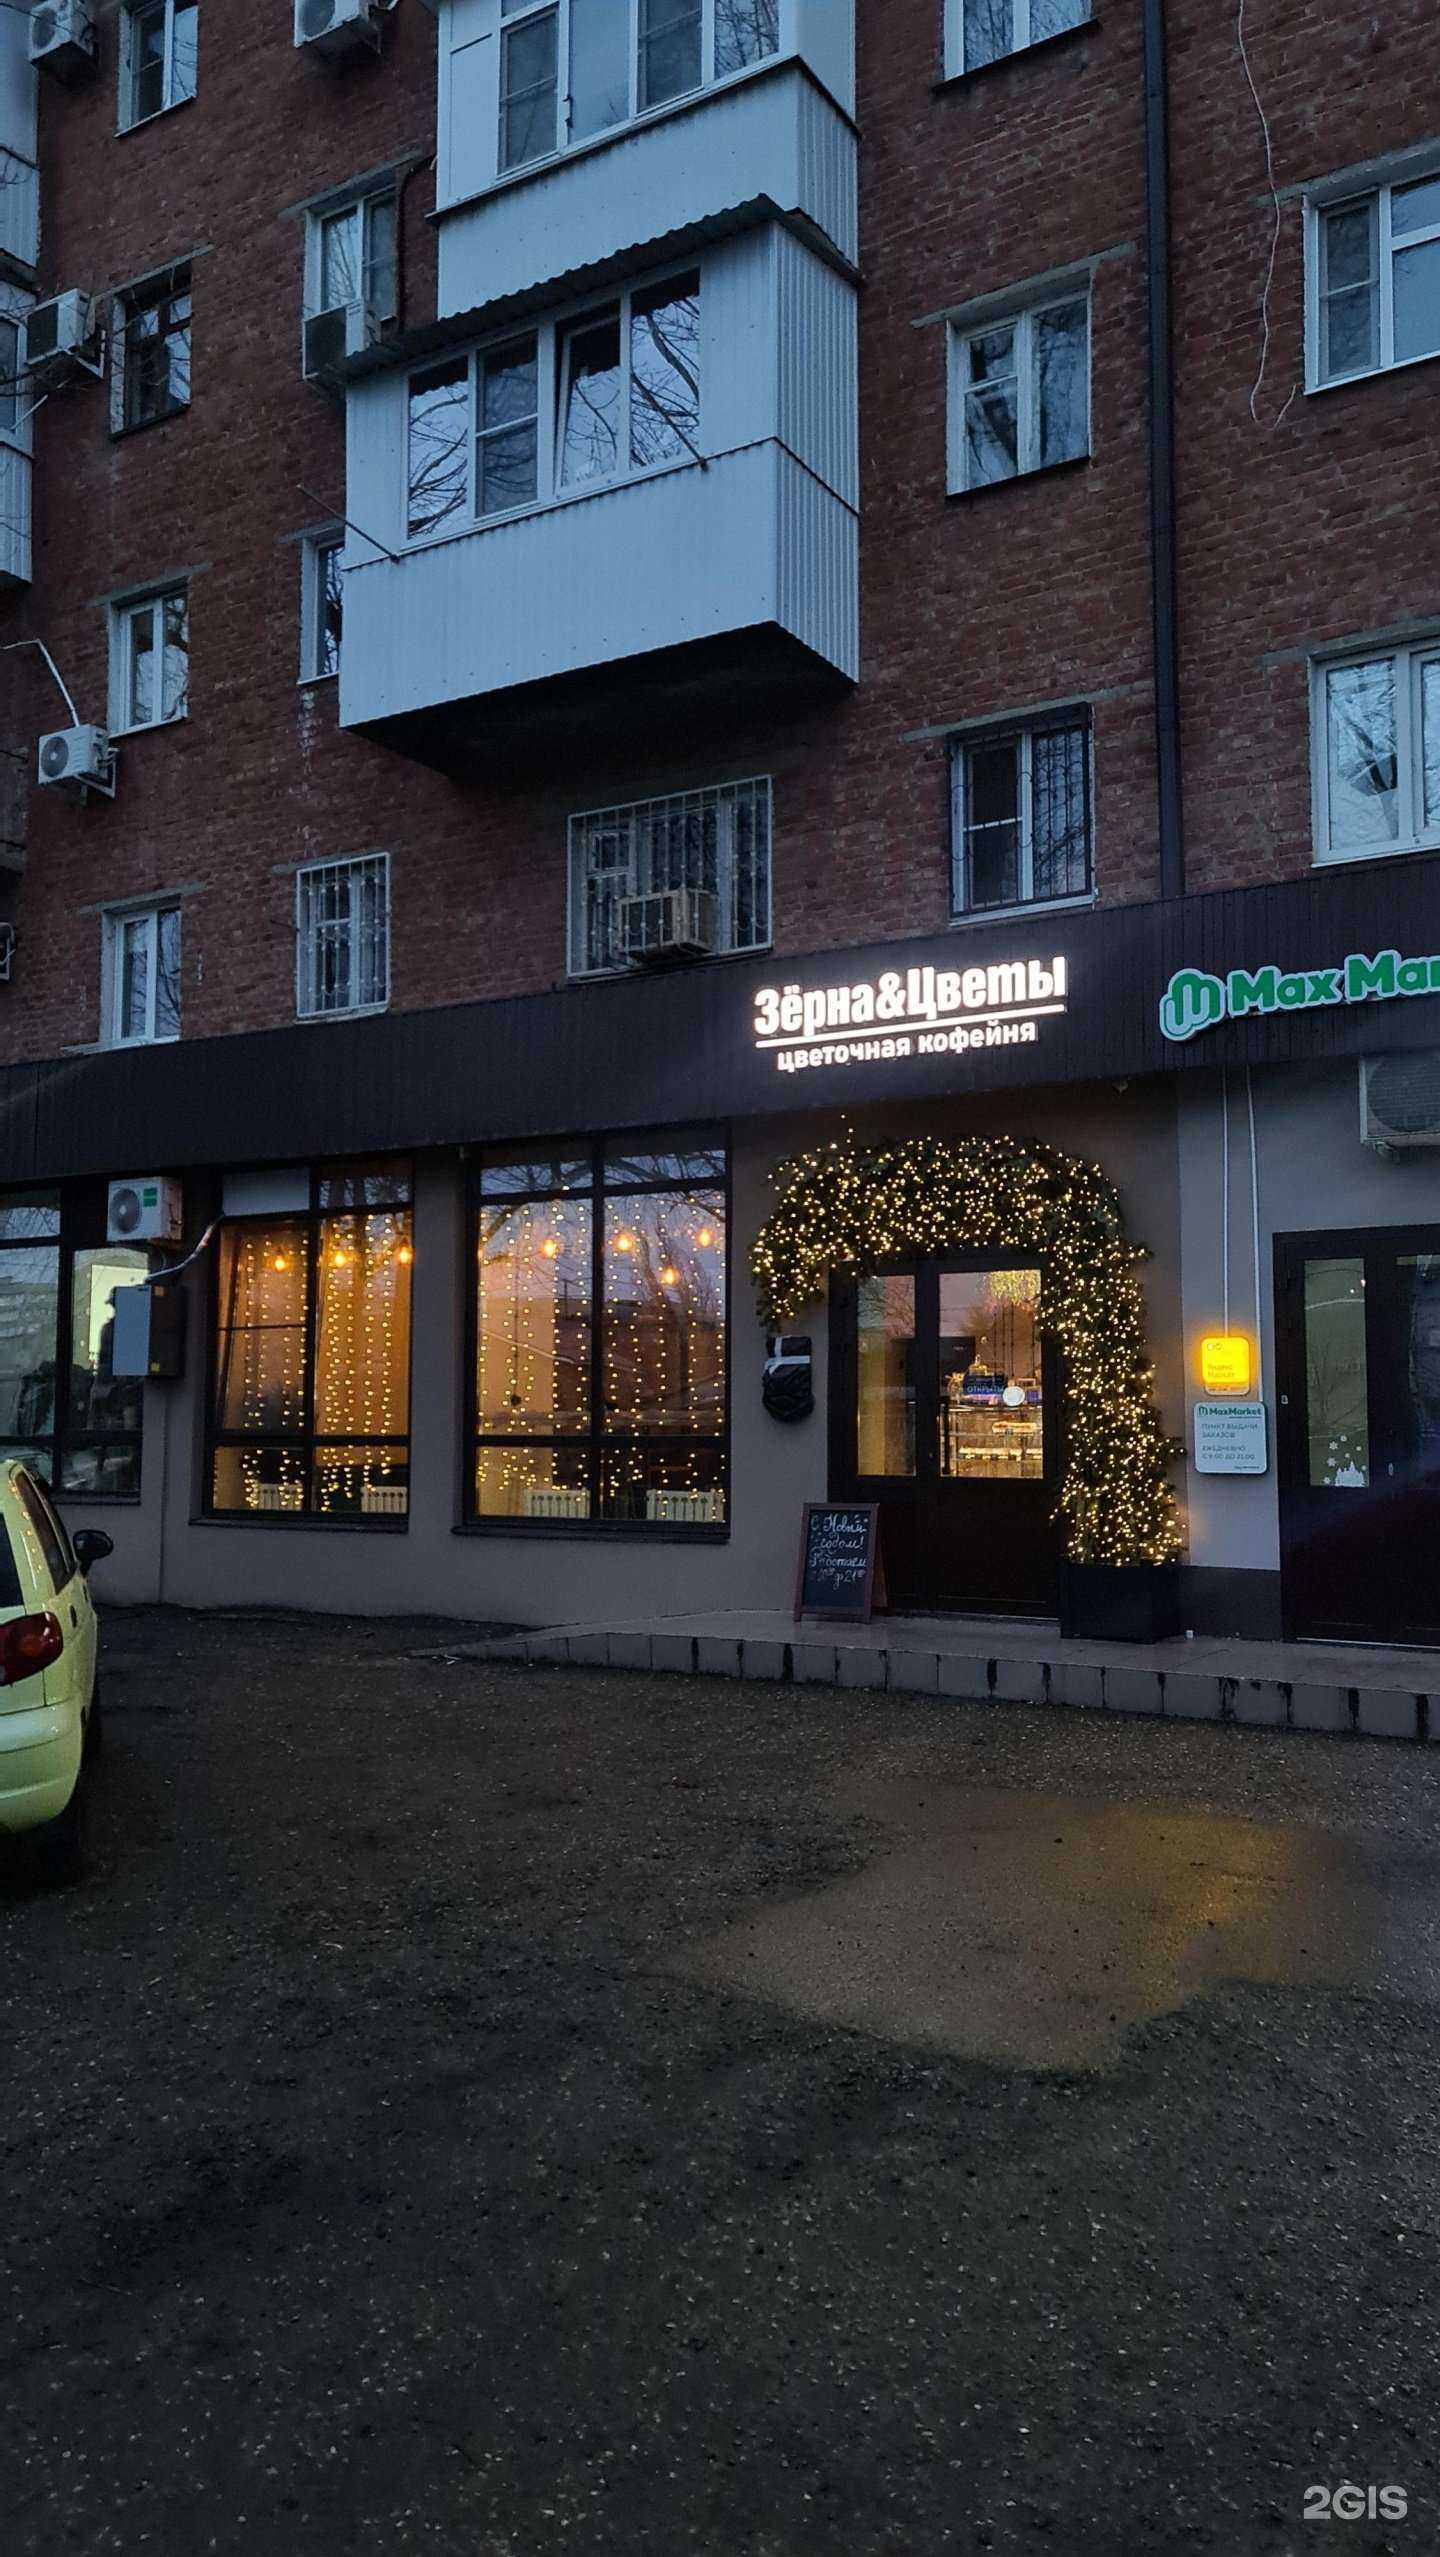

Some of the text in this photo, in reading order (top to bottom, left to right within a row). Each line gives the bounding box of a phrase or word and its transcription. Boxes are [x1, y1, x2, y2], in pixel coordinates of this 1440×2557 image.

[754, 956, 1066, 1036] Зёрна&Цветы
[777, 1020, 1036, 1073] цветочная кофейня
